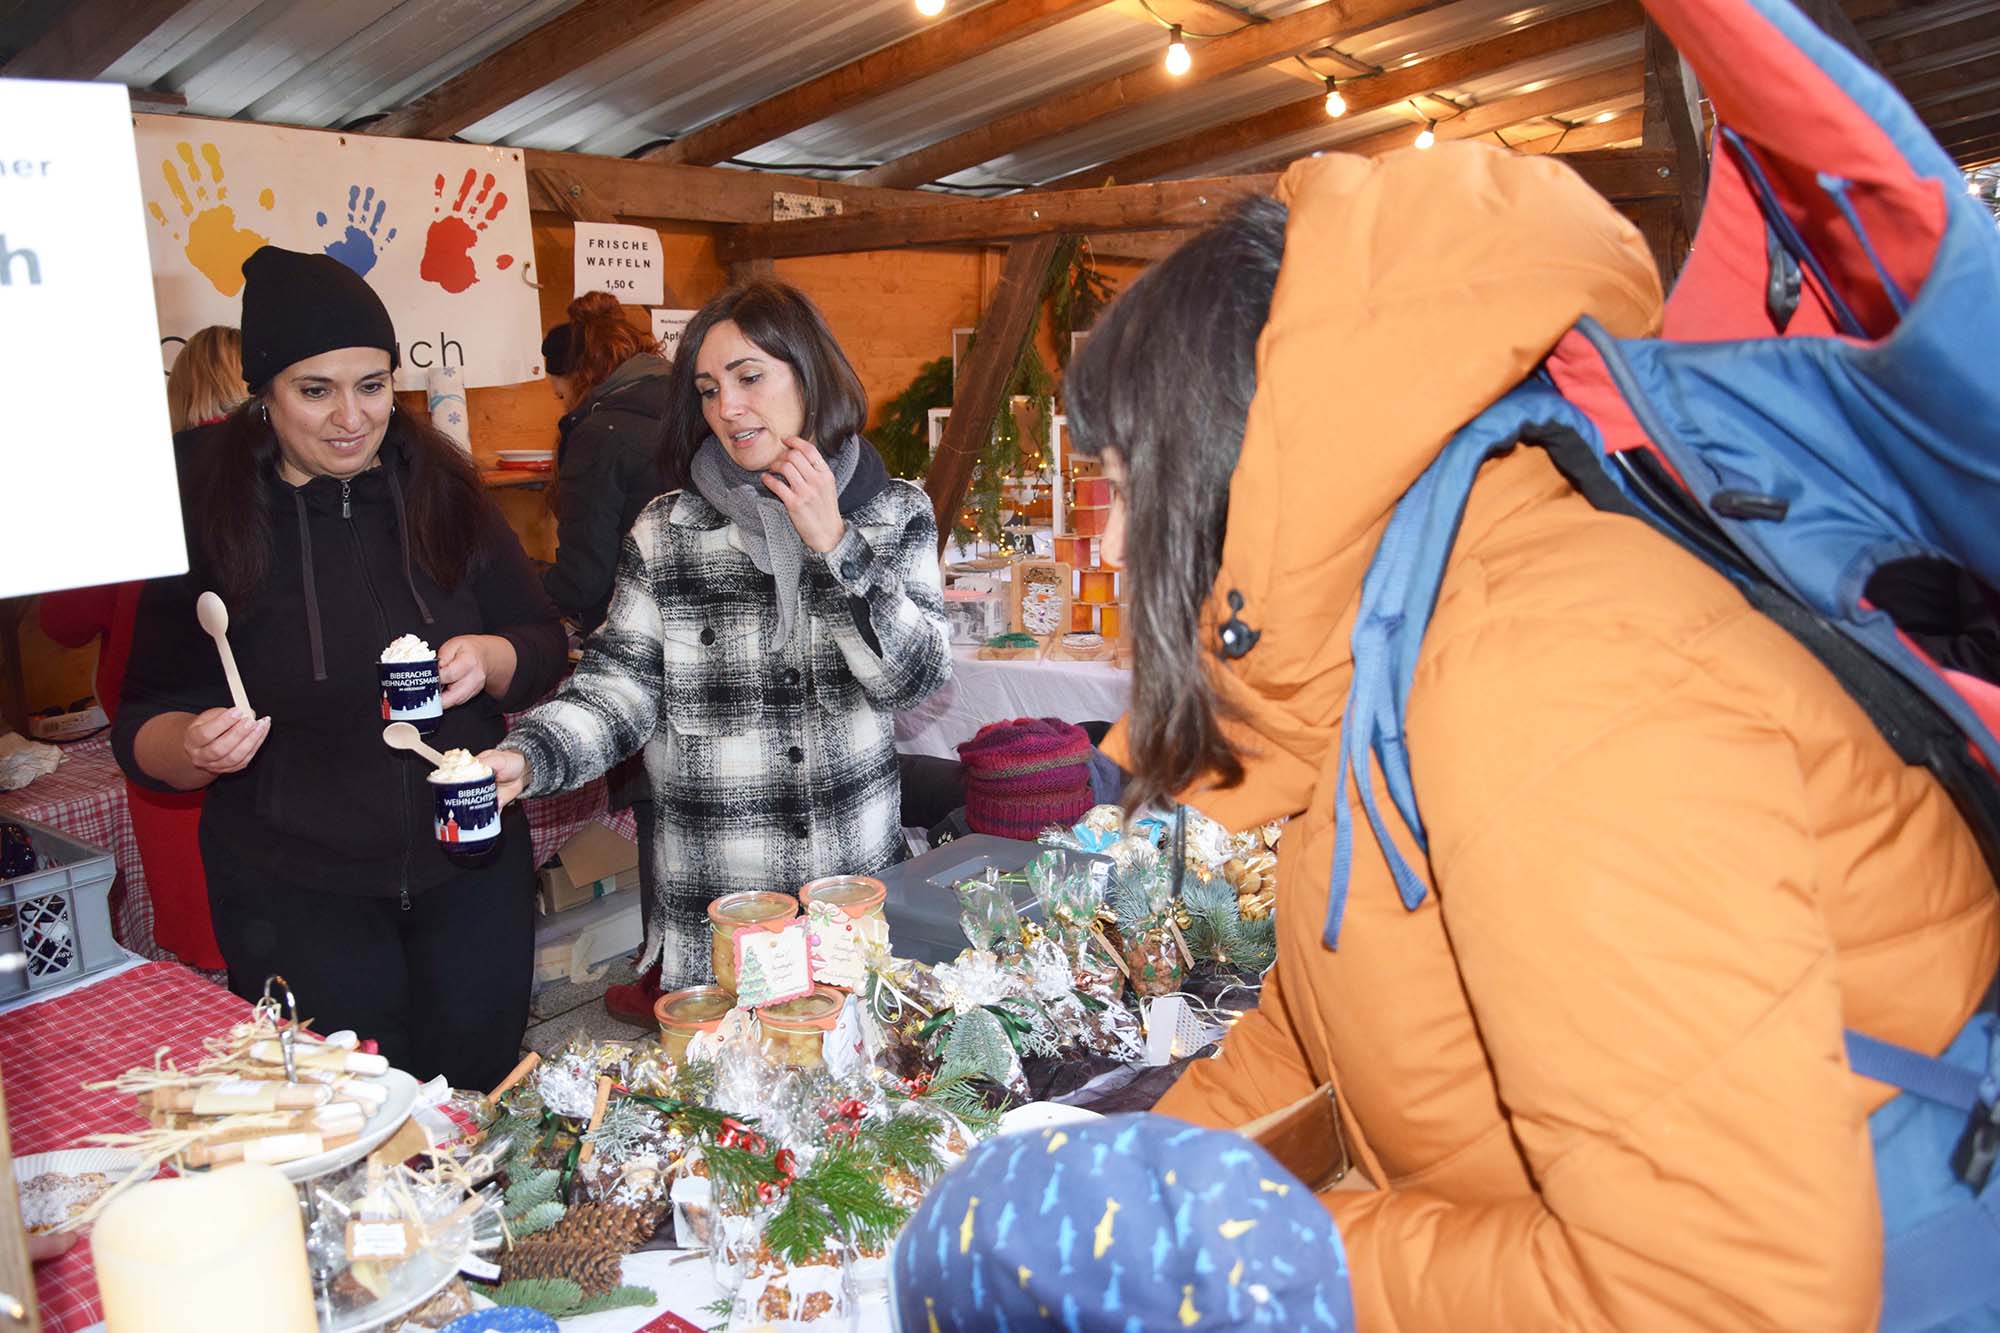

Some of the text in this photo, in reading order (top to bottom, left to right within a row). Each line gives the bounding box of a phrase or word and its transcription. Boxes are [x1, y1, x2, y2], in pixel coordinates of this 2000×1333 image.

[588, 238, 649, 251] FRISCHE
[586, 256, 651, 268] WAFFELN
[605, 279, 635, 290] 1,50 €
[390, 669, 432, 681] BIBERACHER
